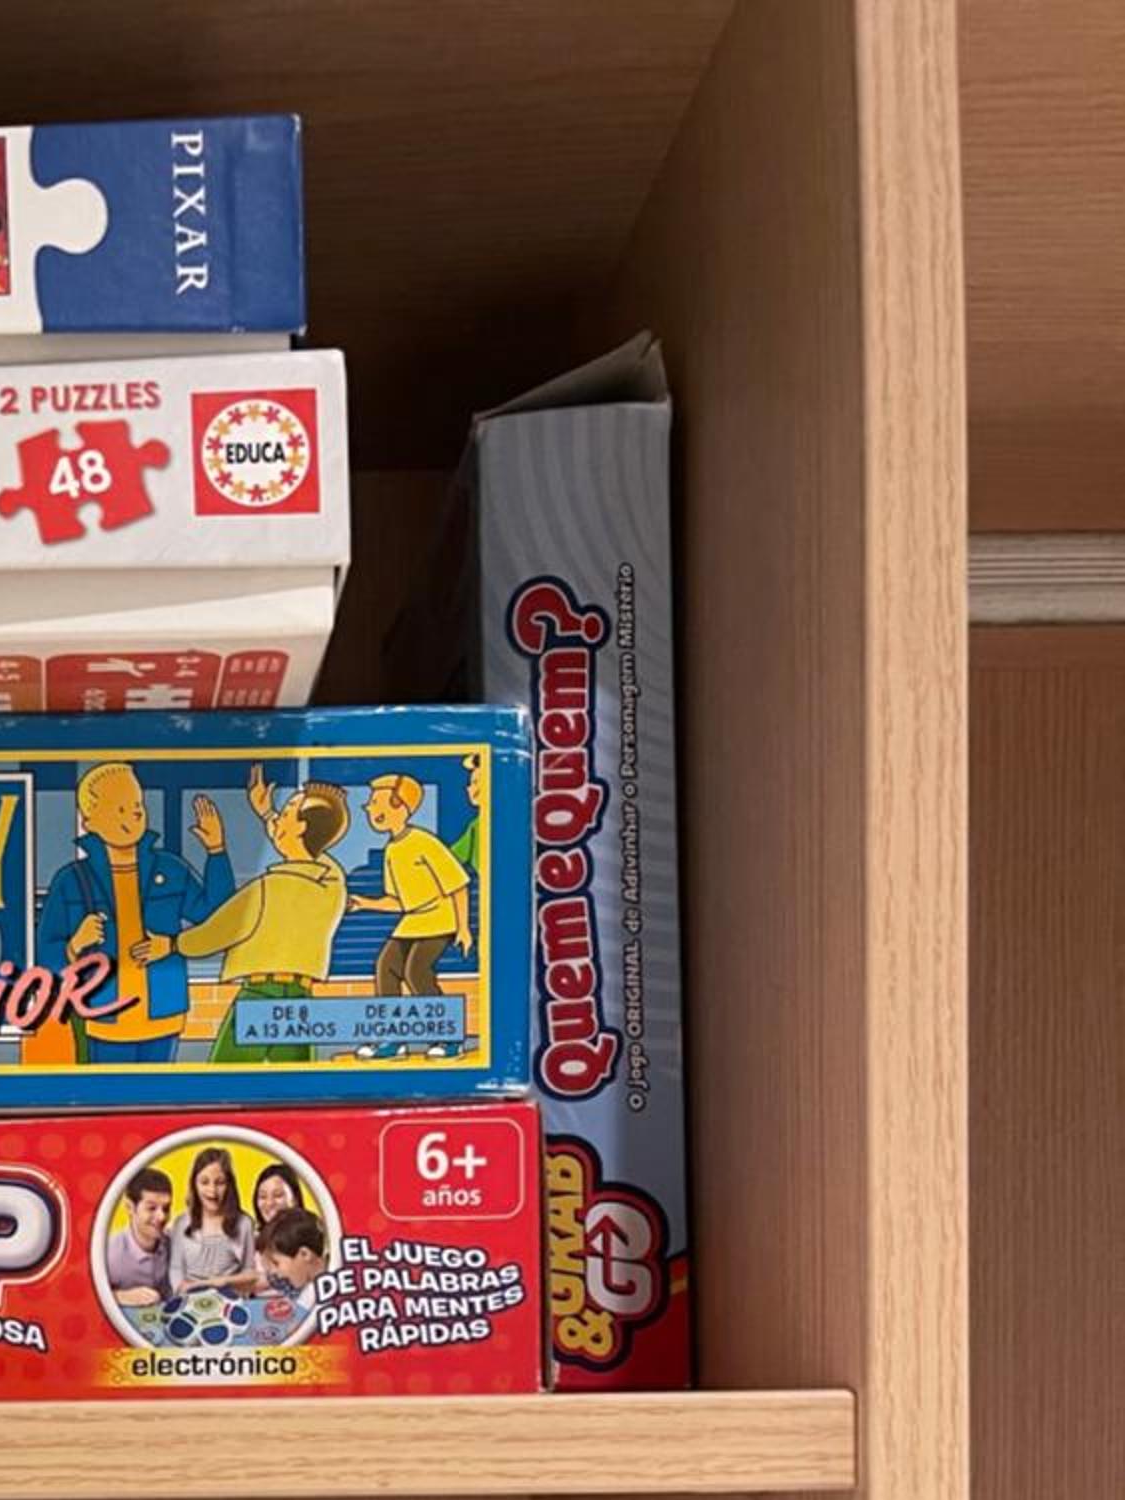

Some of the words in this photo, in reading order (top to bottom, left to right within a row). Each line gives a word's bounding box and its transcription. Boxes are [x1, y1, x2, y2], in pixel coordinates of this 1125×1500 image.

[171, 130, 210, 294] PIXAR
[0, 388, 19, 415] 2
[31, 381, 161, 413] PUZZLES
[225, 440, 287, 465] EDUCA
[48, 450, 113, 498] 48
[616, 562, 636, 648] Mistério
[513, 581, 605, 845] Quem?
[619, 651, 640, 778] Personagem
[622, 783, 636, 797] o
[621, 803, 640, 901] Adivinhar
[623, 909, 641, 932] de
[542, 897, 617, 1096] Quem
[623, 940, 642, 1036] ORIGINAL
[245, 1023, 259, 1038] A
[263, 1022, 279, 1037] 13
[287, 1018, 337, 1038] AÑOS
[272, 1006, 295, 1021] DE
[352, 1019, 457, 1038] JUGADORES
[365, 1005, 387, 1020] DE
[391, 1005, 403, 1019] 4
[407, 1005, 420, 1019] A
[423, 1004, 446, 1018] 20
[626, 1041, 647, 1088] jogo
[628, 1094, 644, 1110] O
[416, 1132, 487, 1182] 6+
[422, 1184, 482, 1207] años
[342, 1239, 378, 1262] EL
[384, 1240, 487, 1268] JUEGO
[585, 1201, 653, 1315] GO
[315, 1272, 356, 1301] DE
[363, 1264, 520, 1293] PALABRAS
[318, 1302, 398, 1335] PARA
[405, 1286, 524, 1319] MENTES
[360, 1318, 490, 1353] RÁPIDAS
[557, 1310, 615, 1358] &
[131, 1350, 297, 1378] electrónico
